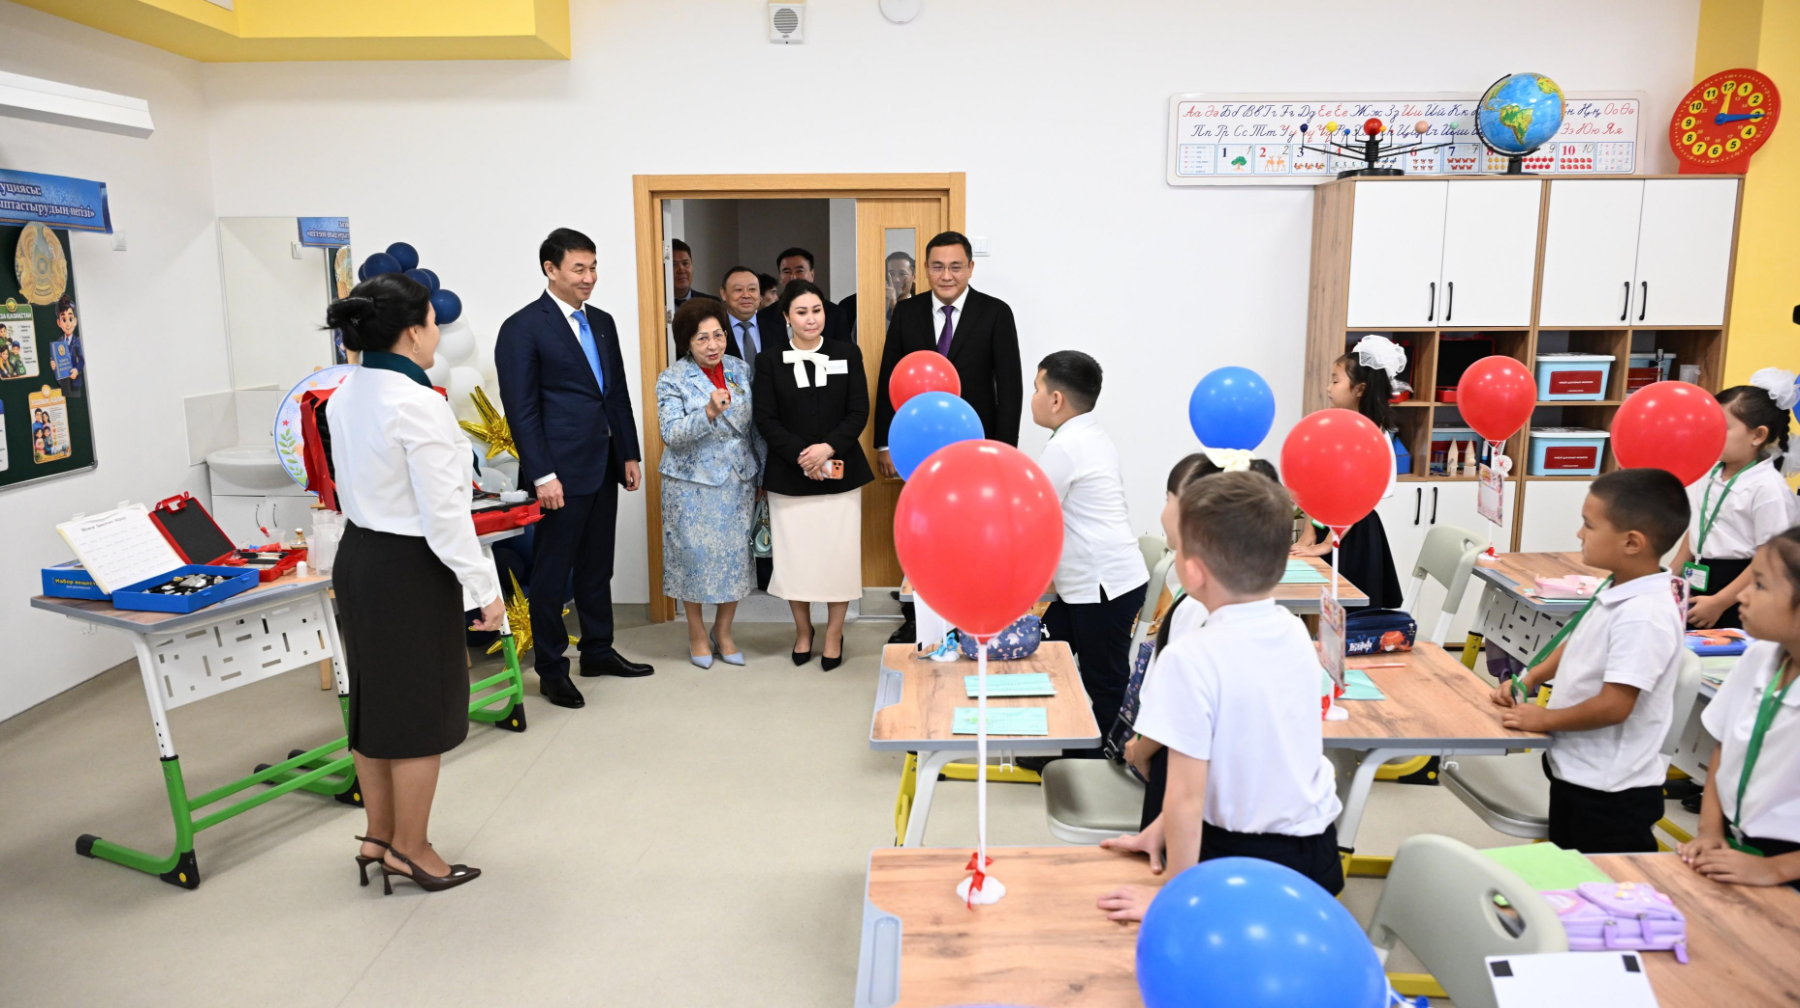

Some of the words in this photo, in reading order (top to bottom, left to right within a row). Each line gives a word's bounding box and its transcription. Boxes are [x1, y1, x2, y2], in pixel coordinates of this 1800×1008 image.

[1722, 82, 1735, 92] 12
[1743, 84, 1749, 93] 1
[1706, 89, 1717, 98] 11
[1752, 95, 1760, 104] 2
[1182, 105, 1202, 118] Аа
[1690, 102, 1702, 111] 10
[1686, 118, 1692, 127] 9
[1234, 124, 1248, 137] Сс
[1746, 128, 1752, 136] 4
[1686, 134, 1694, 142] 8
[1696, 144, 1703, 152] 7
[1730, 140, 1737, 150] 5
[1222, 147, 1228, 158] 1
[1260, 147, 1267, 158] 2
[1296, 147, 1304, 158] 3
[1448, 146, 1456, 156] 7
[1562, 146, 1576, 156] 10
[1712, 146, 1719, 155] 6
[0, 182, 41, 196] уциясы:
[0, 200, 70, 216] ыптастырудың
